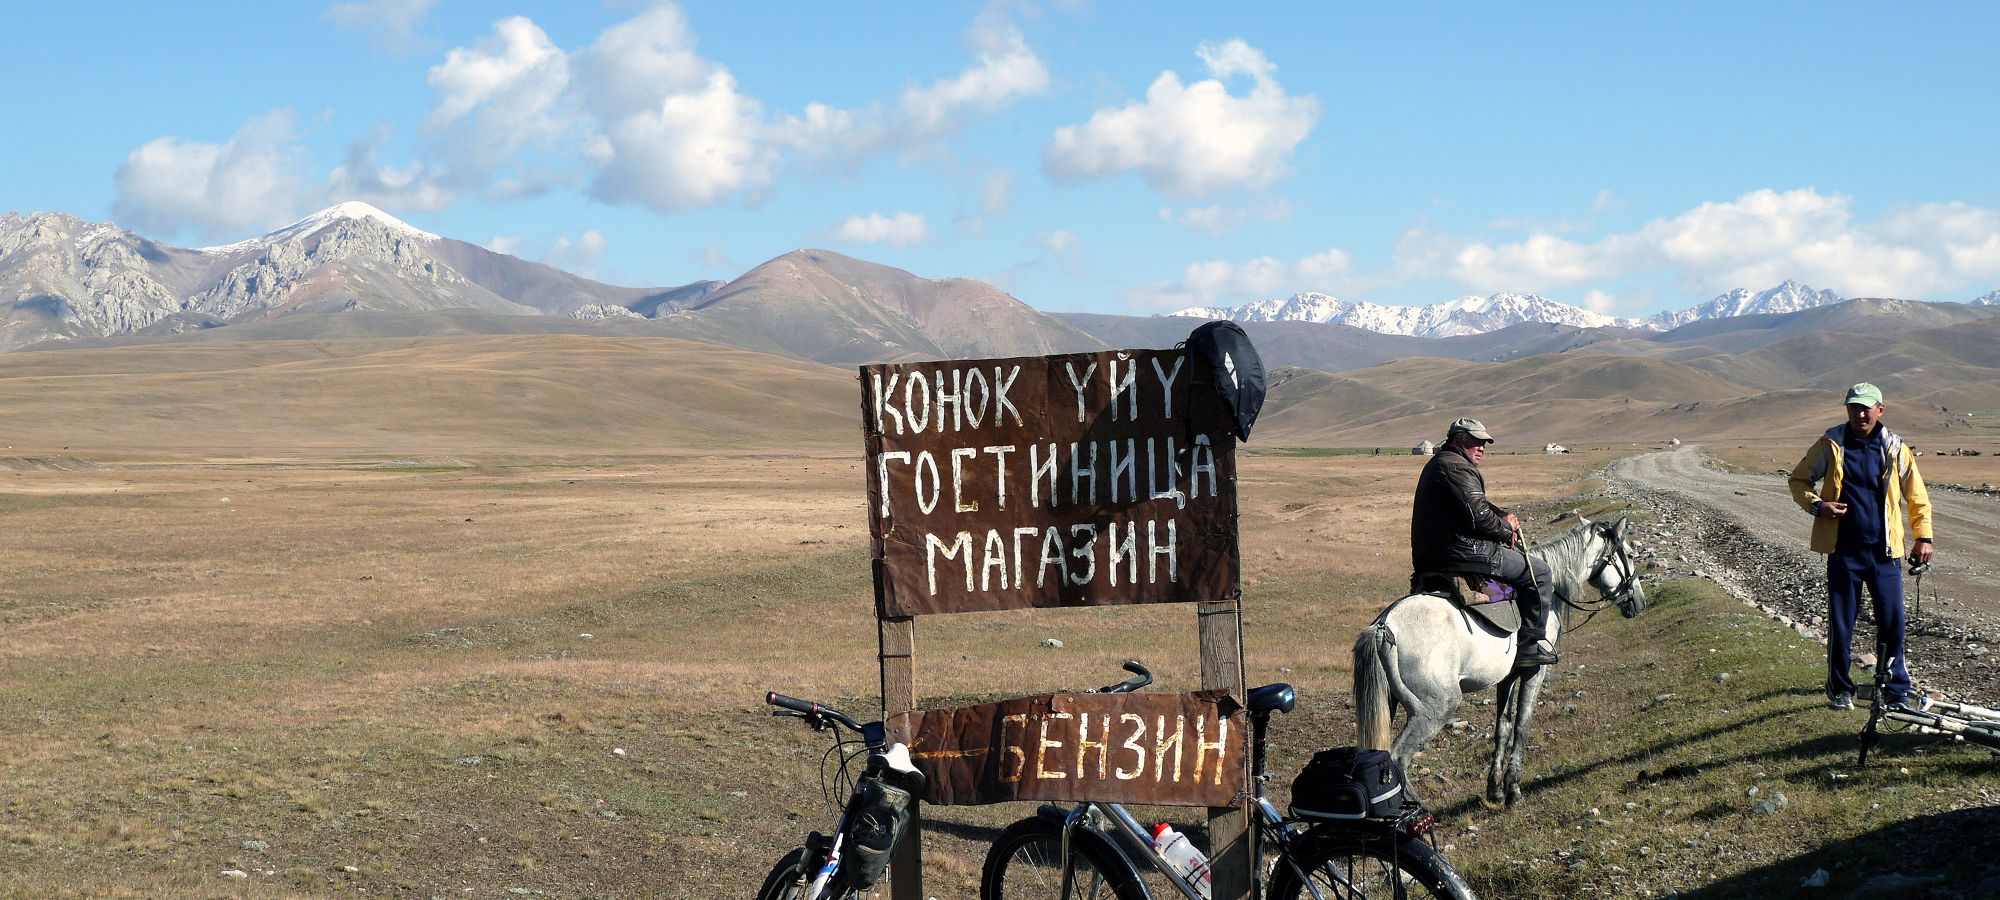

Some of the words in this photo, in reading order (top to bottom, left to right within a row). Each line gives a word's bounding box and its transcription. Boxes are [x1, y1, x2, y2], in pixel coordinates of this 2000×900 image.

[874, 365, 1023, 435] КОНОК
[879, 433, 1217, 518] ГОСТИНИЦА
[925, 518, 1177, 595] МАГАЗИН
[1000, 713, 1227, 785] БЕНЗИН
